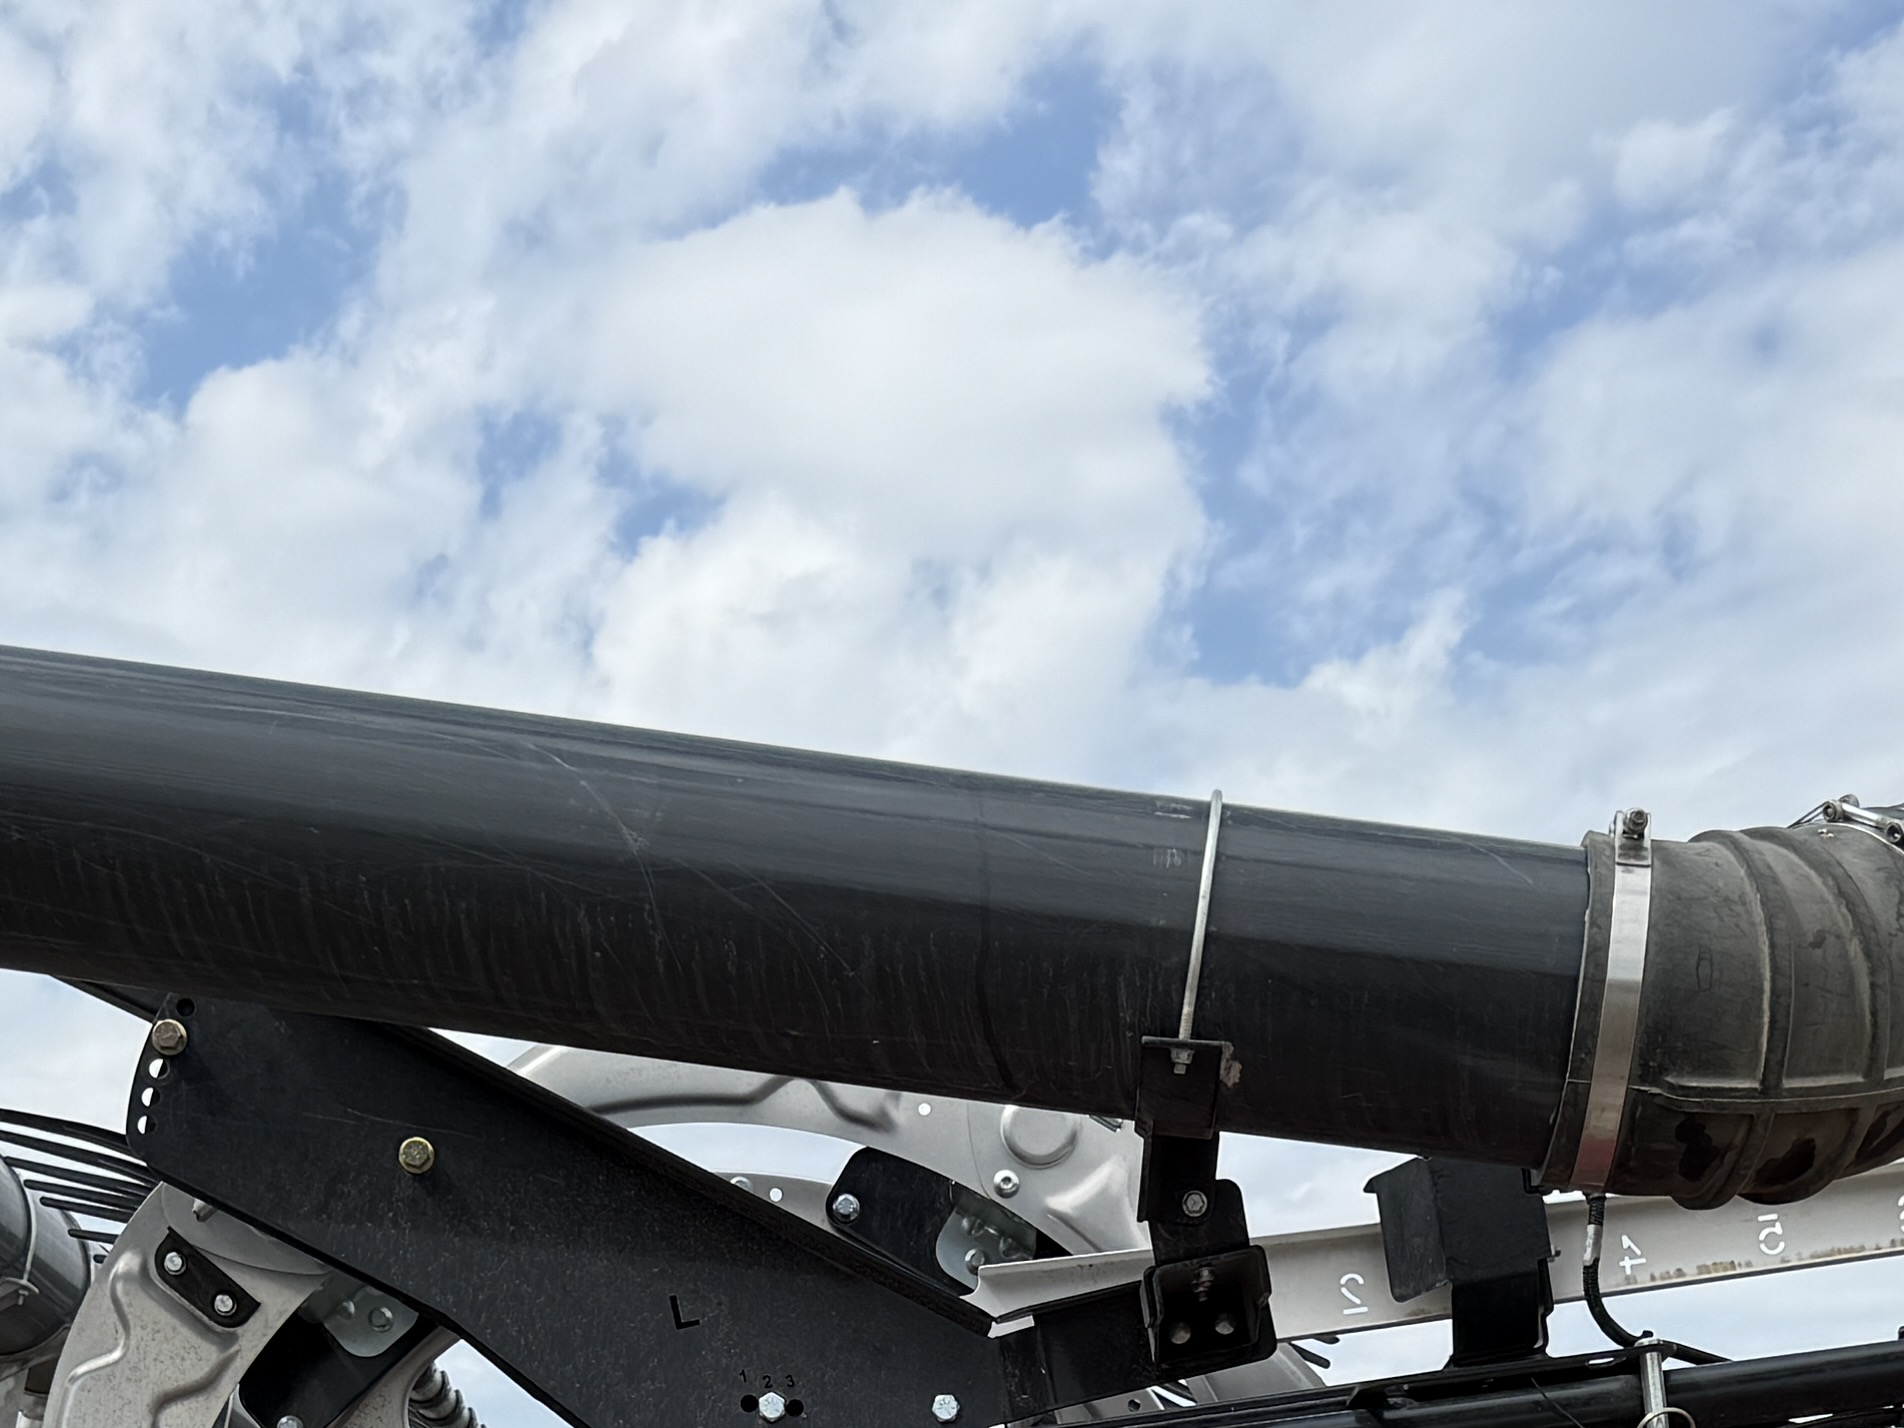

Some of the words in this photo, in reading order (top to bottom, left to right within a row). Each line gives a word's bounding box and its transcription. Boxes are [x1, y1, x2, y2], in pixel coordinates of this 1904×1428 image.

[669, 1294, 701, 1331] L
[739, 1369, 748, 1383] 1
[762, 1374, 773, 1389] 2
[784, 1374, 795, 1388] 3
